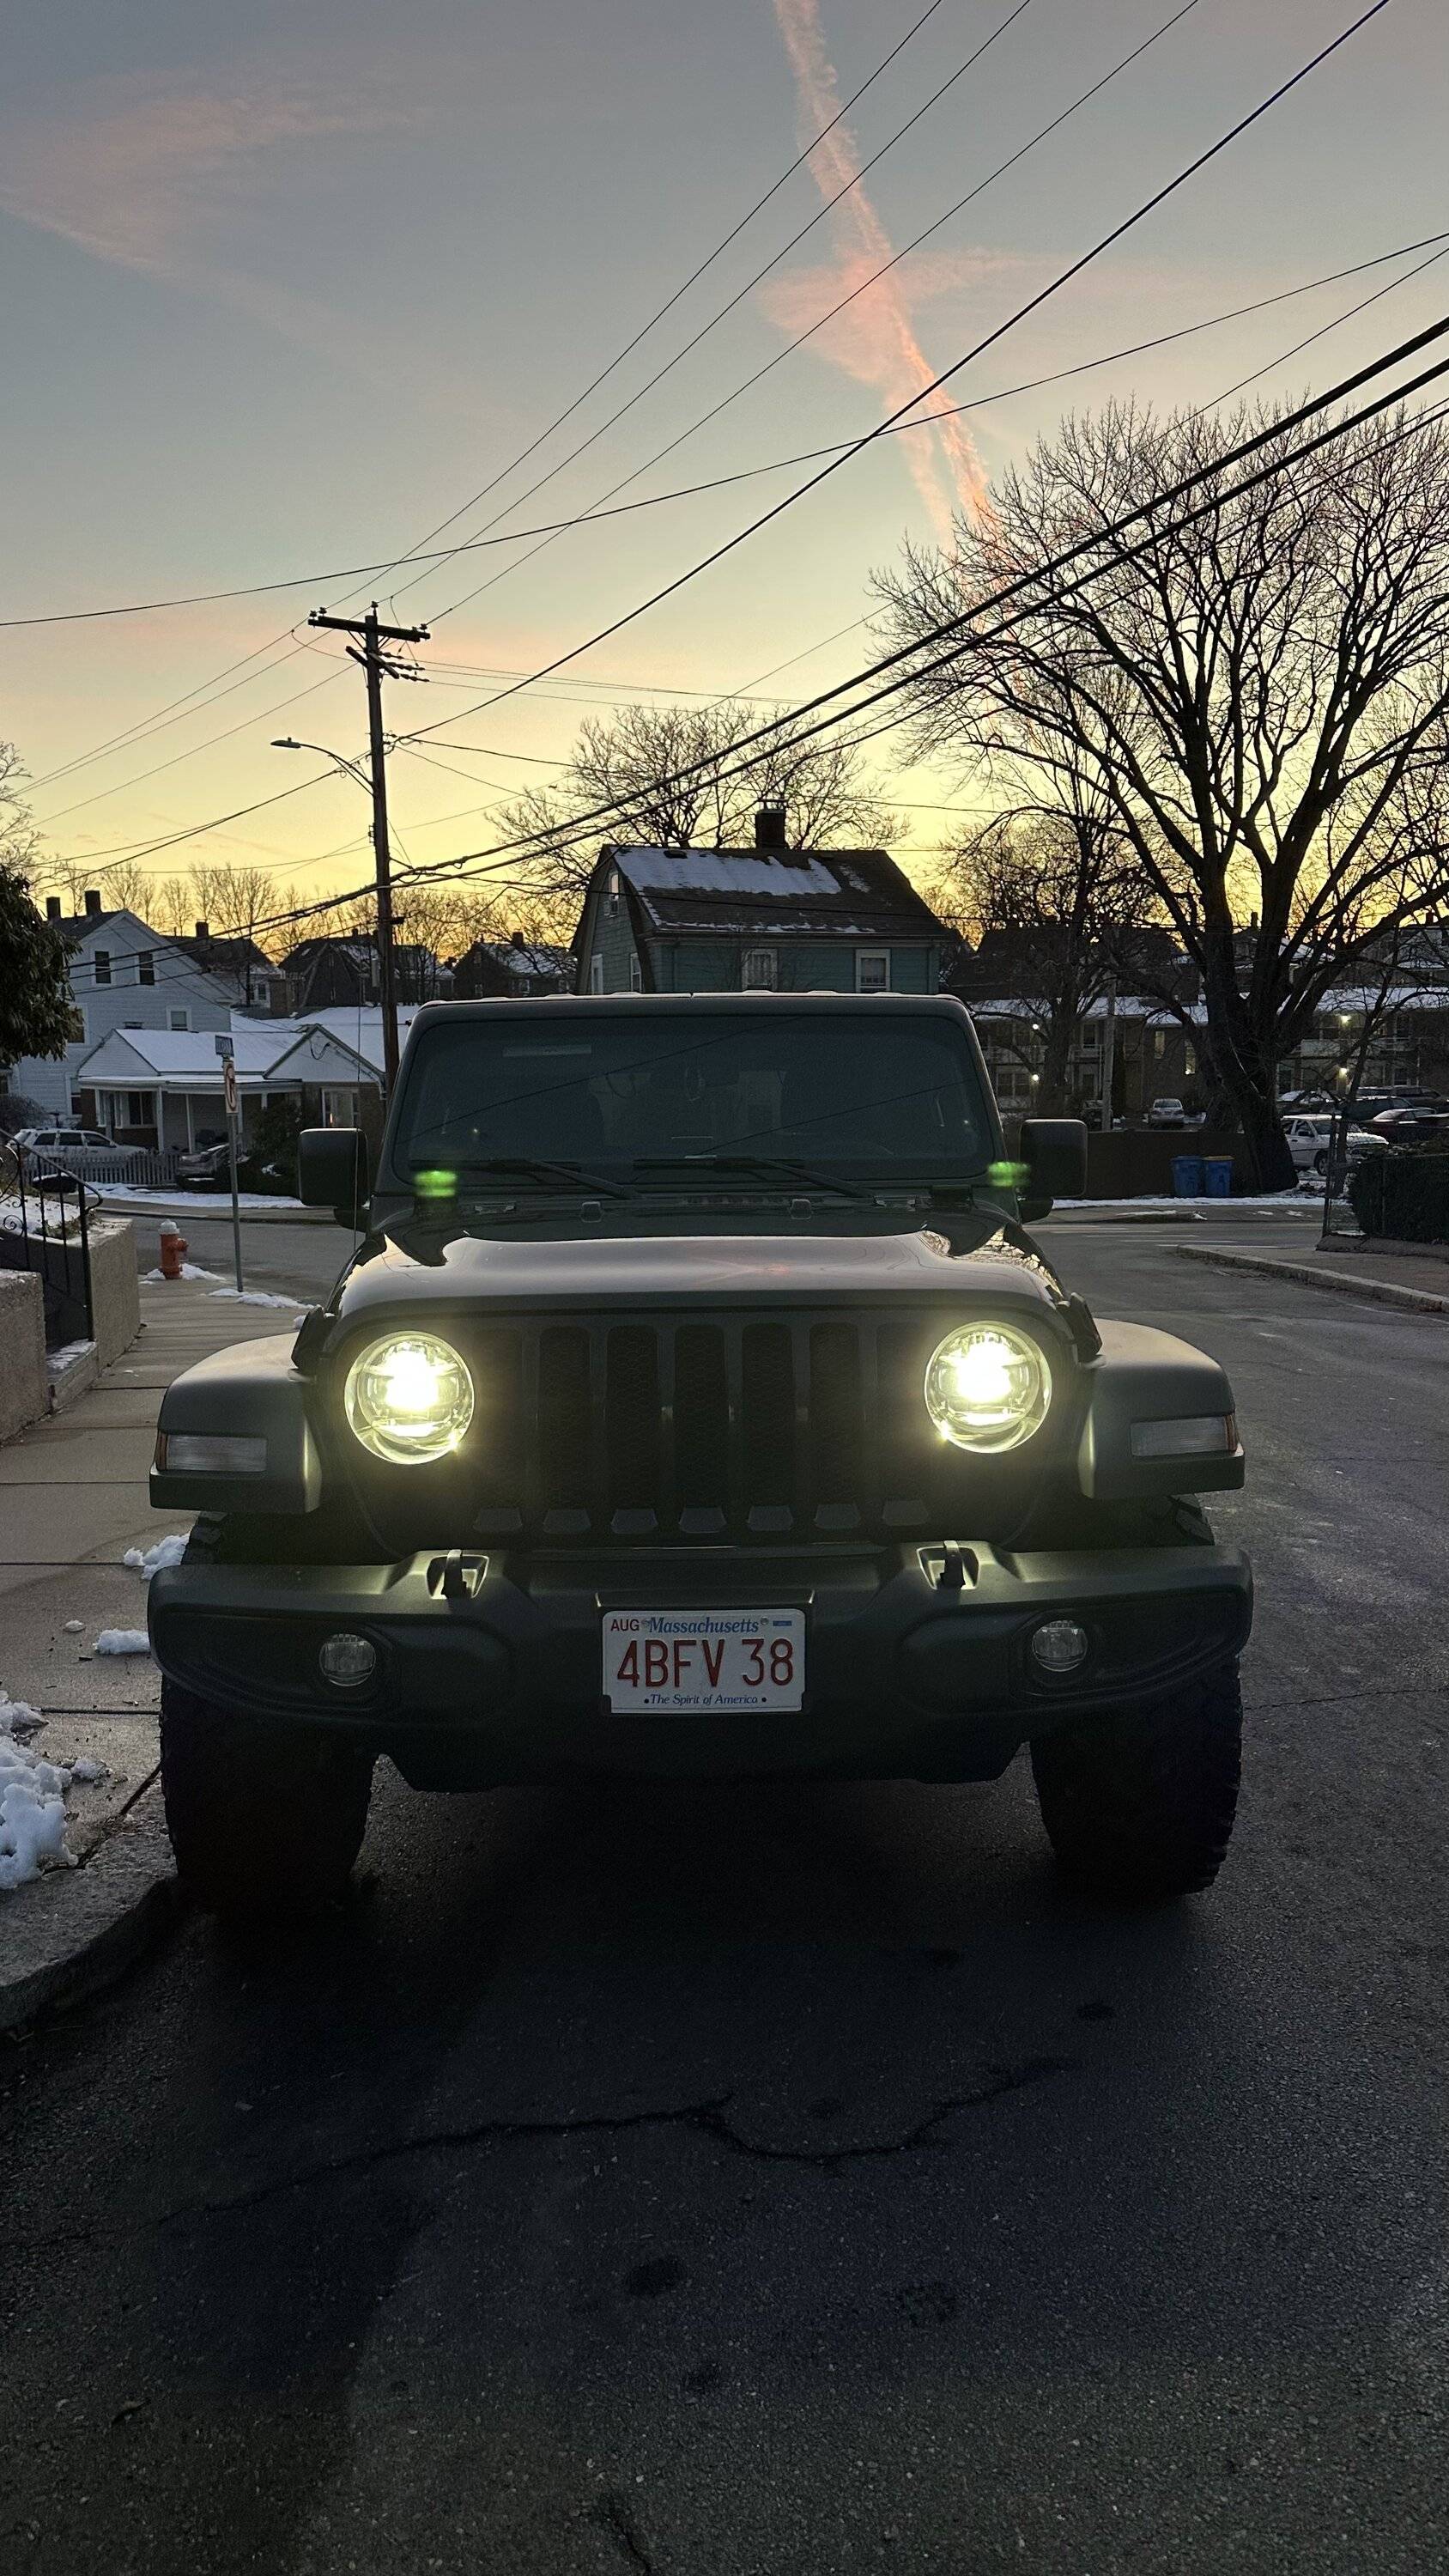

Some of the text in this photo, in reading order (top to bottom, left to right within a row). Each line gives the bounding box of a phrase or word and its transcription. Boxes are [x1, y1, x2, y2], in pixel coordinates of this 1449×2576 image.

[610, 1619, 640, 1631] AUG
[648, 1616, 760, 1634] Massachusetts
[617, 1637, 794, 1687] 4BFV 38
[651, 1693, 758, 1705] The Spirit of America
